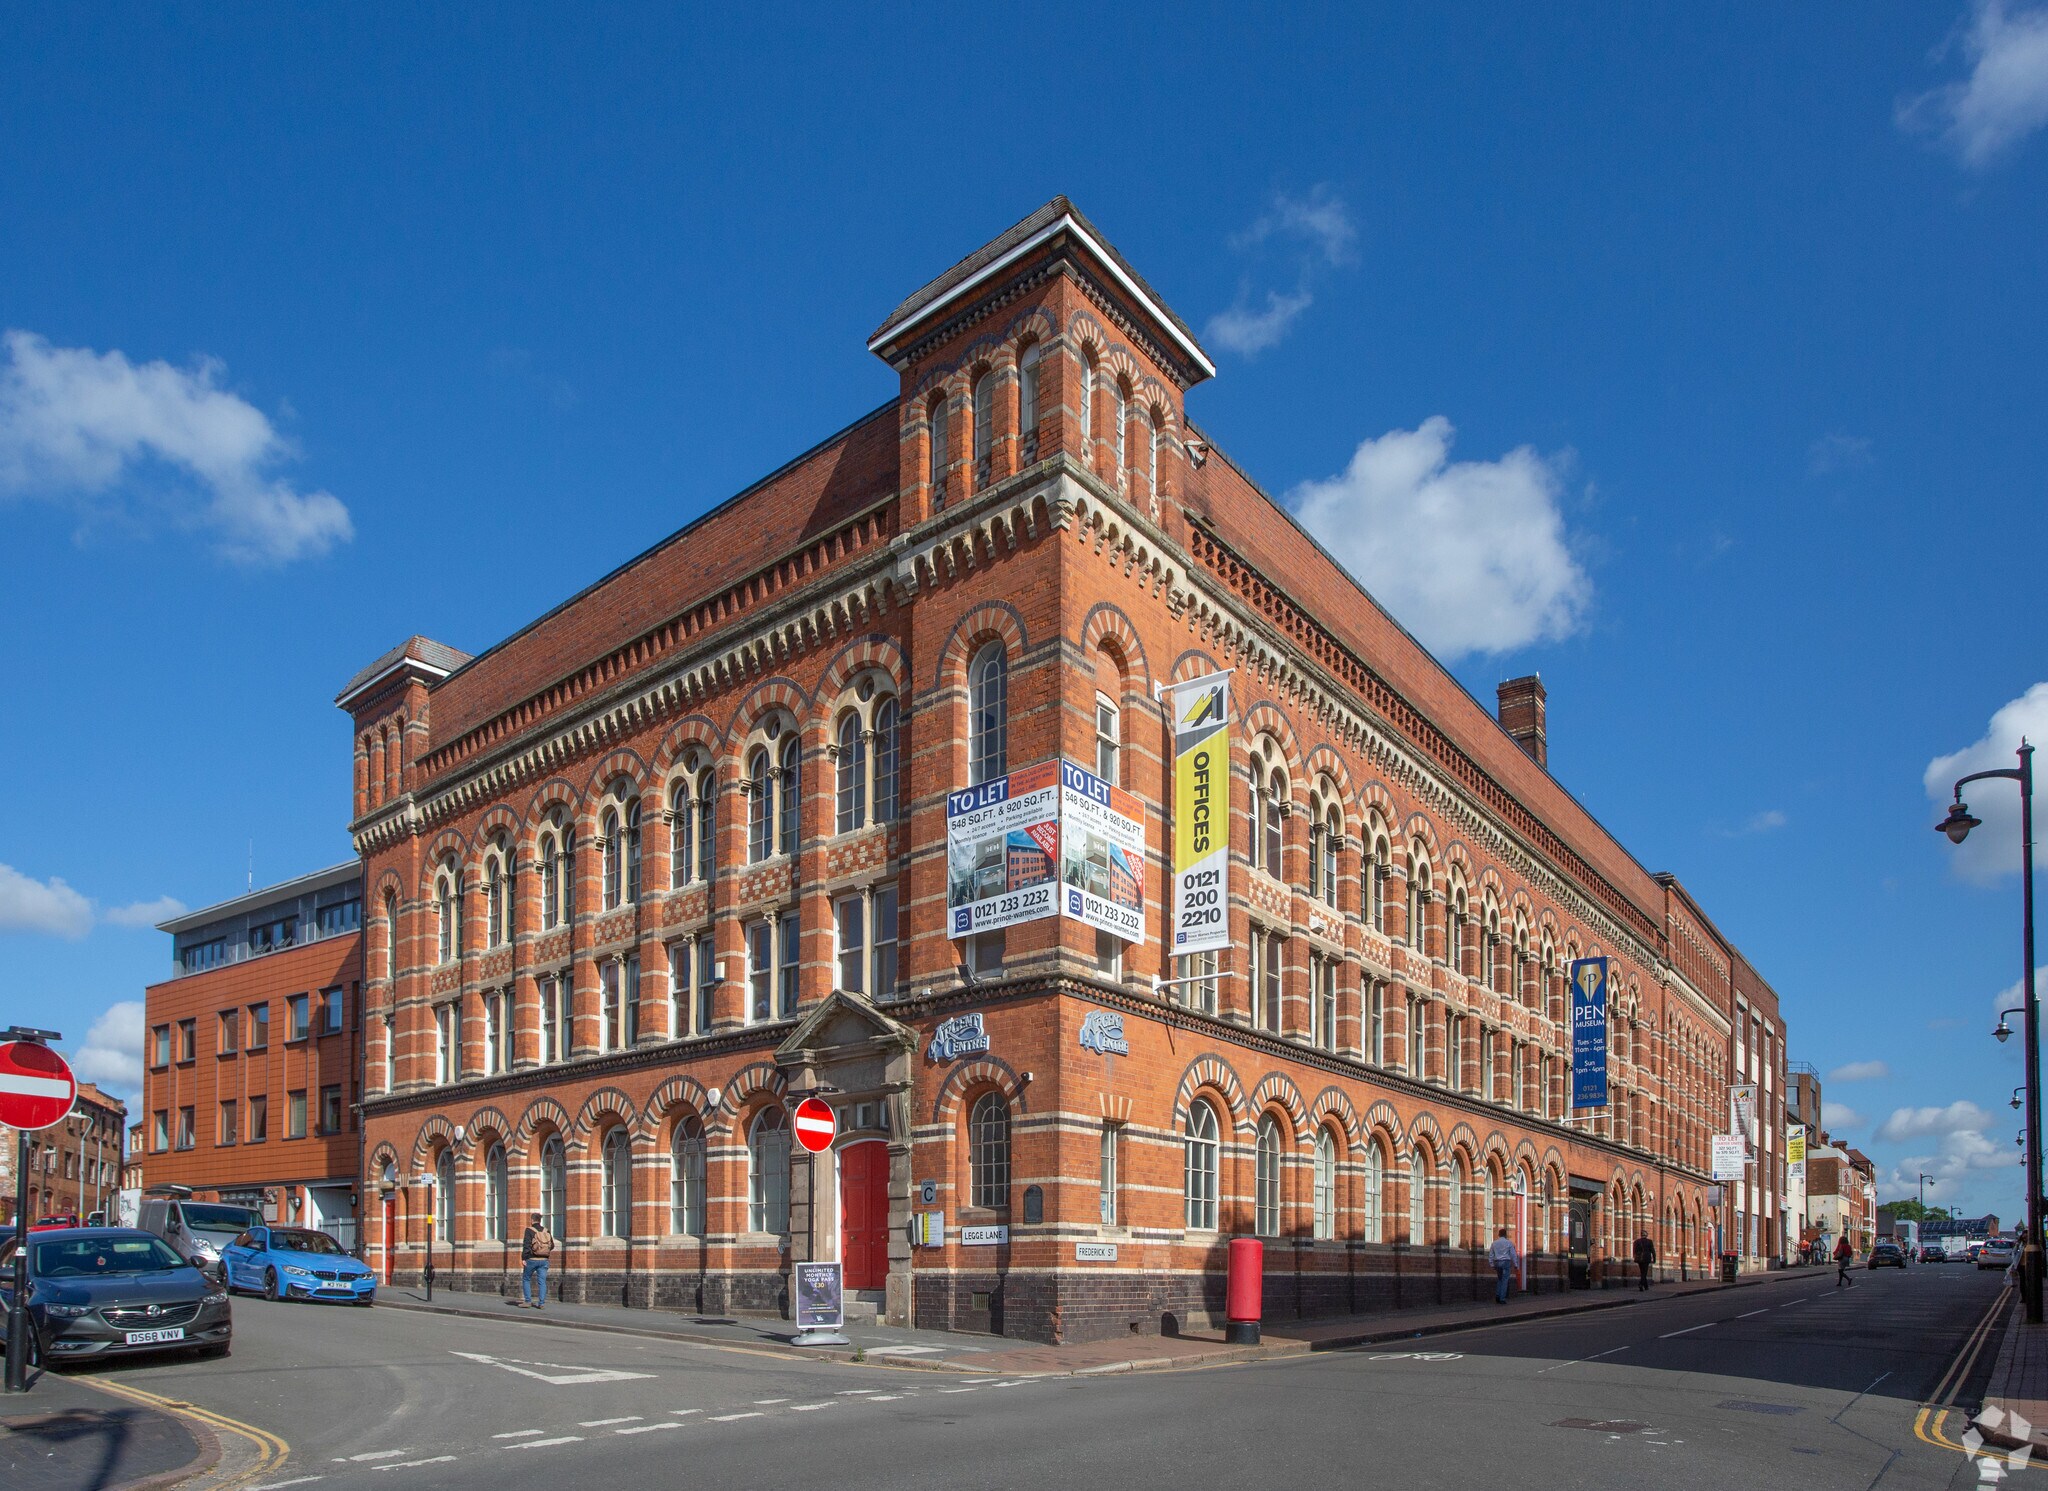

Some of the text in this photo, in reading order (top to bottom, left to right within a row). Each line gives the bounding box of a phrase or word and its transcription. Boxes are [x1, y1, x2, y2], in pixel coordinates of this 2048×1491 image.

[1064, 764, 1084, 791] TO
[1087, 776, 1109, 804] LET
[950, 780, 1007, 814] TO LET
[1194, 751, 1209, 853] OFFICES
[951, 818, 966, 831] 548
[968, 808, 996, 825] SQ.FT.
[998, 805, 1004, 816] &
[1006, 800, 1022, 813] 920
[1005, 806, 1043, 823] Parking available
[1065, 791, 1078, 805] 548
[1080, 797, 1102, 817] SQ.FT.
[1103, 810, 1108, 820] &
[1109, 814, 1121, 827] 920
[981, 821, 996, 831] access
[996, 825, 1006, 833] Self
[1006, 817, 1028, 830] contained
[1028, 815, 1038, 824] with
[1043, 823, 1057, 835] JUST
[954, 835, 972, 845] Monthly
[1031, 829, 1054, 853] AVAILABLE
[1036, 824, 1056, 845] BECOME
[1184, 869, 1220, 889] 0121
[975, 889, 1049, 919] 0121 233 2232
[1184, 889, 1218, 909] 200
[975, 905, 1050, 928] www.prince-warnes.com
[1085, 897, 1139, 930] 0121 233 2232
[1181, 907, 1221, 928] 2210
[1085, 912, 1139, 938] www.prince-warnes.com
[1575, 1004, 1605, 1021] PEN
[1575, 1019, 1605, 1028] MUSEUM
[944, 1037, 987, 1058] CENTRE
[1094, 1030, 1128, 1053] CENTRE
[1582, 1084, 1598, 1092] 0121
[1588, 1091, 1605, 1099] 9834
[924, 1187, 933, 1202] C
[964, 1230, 1003, 1240] LEGGE LANE
[1079, 1247, 1115, 1257] FREDERICK ST
[131, 1330, 179, 1343] DS68 VNV
